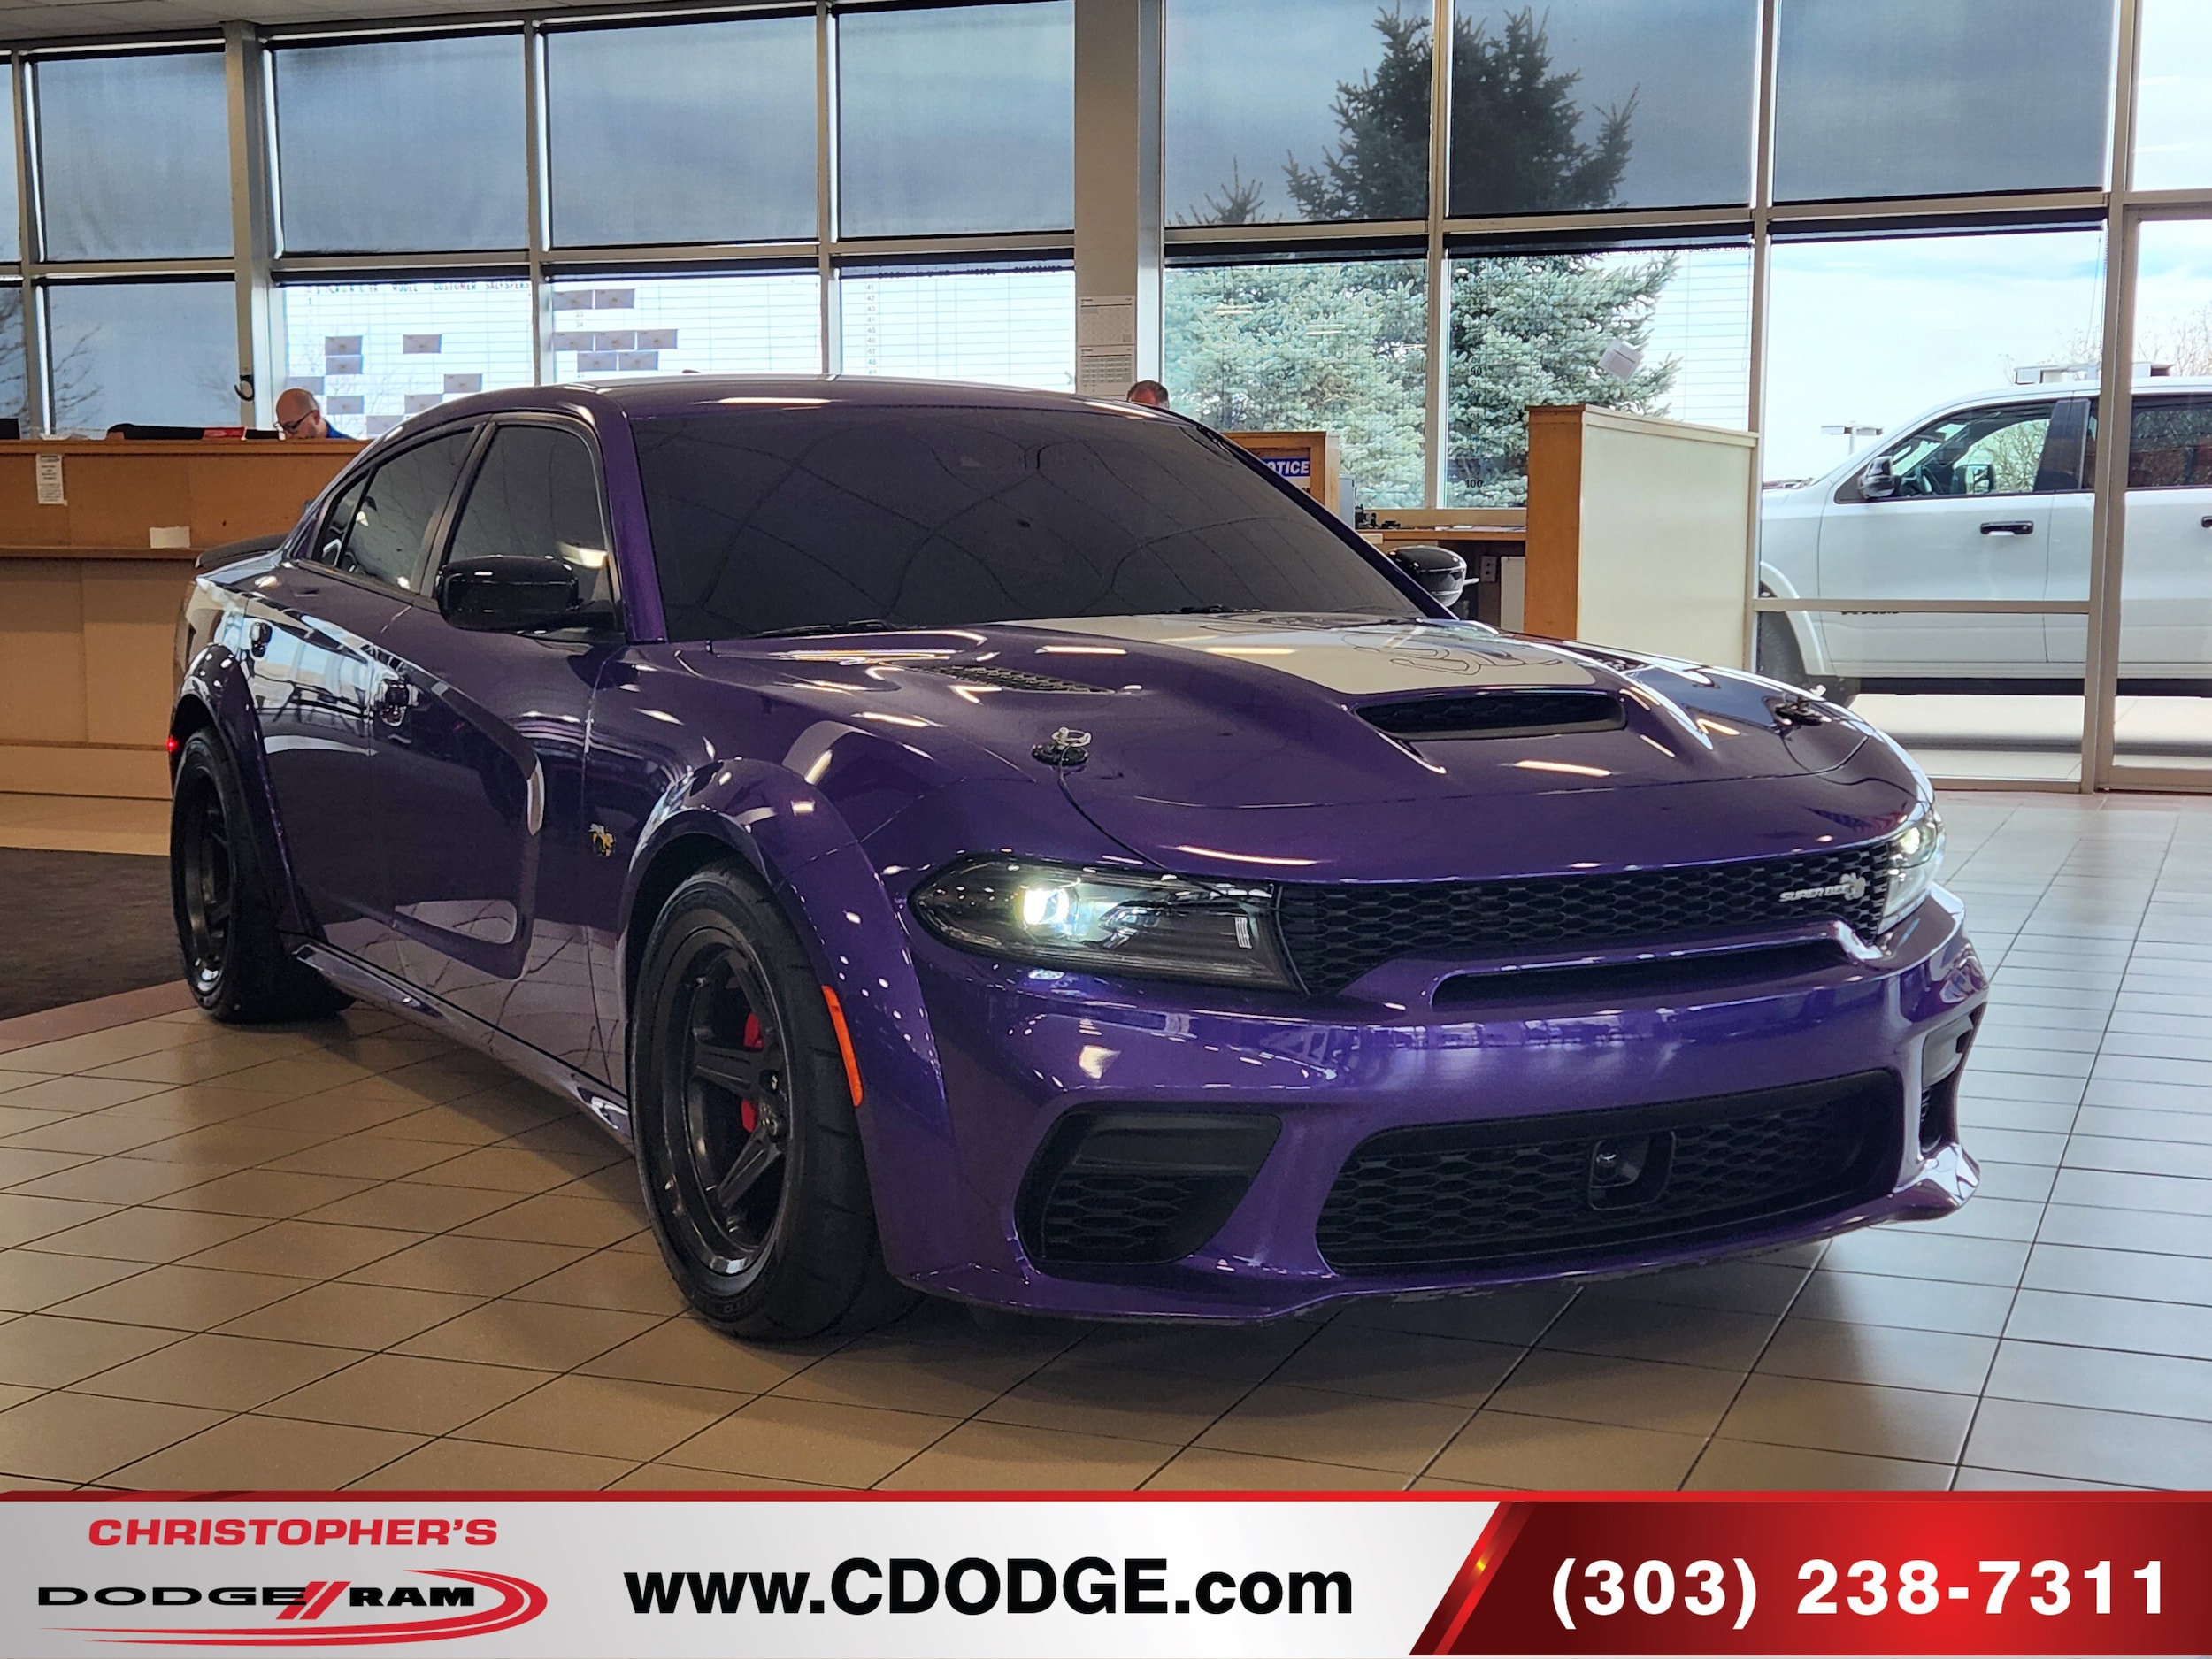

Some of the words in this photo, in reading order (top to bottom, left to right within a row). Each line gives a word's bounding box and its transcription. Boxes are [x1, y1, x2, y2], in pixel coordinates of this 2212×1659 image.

[1471, 366, 1482, 376] 90
[1264, 460, 1310, 475] OTICE
[1465, 479, 1484, 488] 100
[1778, 887, 1824, 902] SUPER
